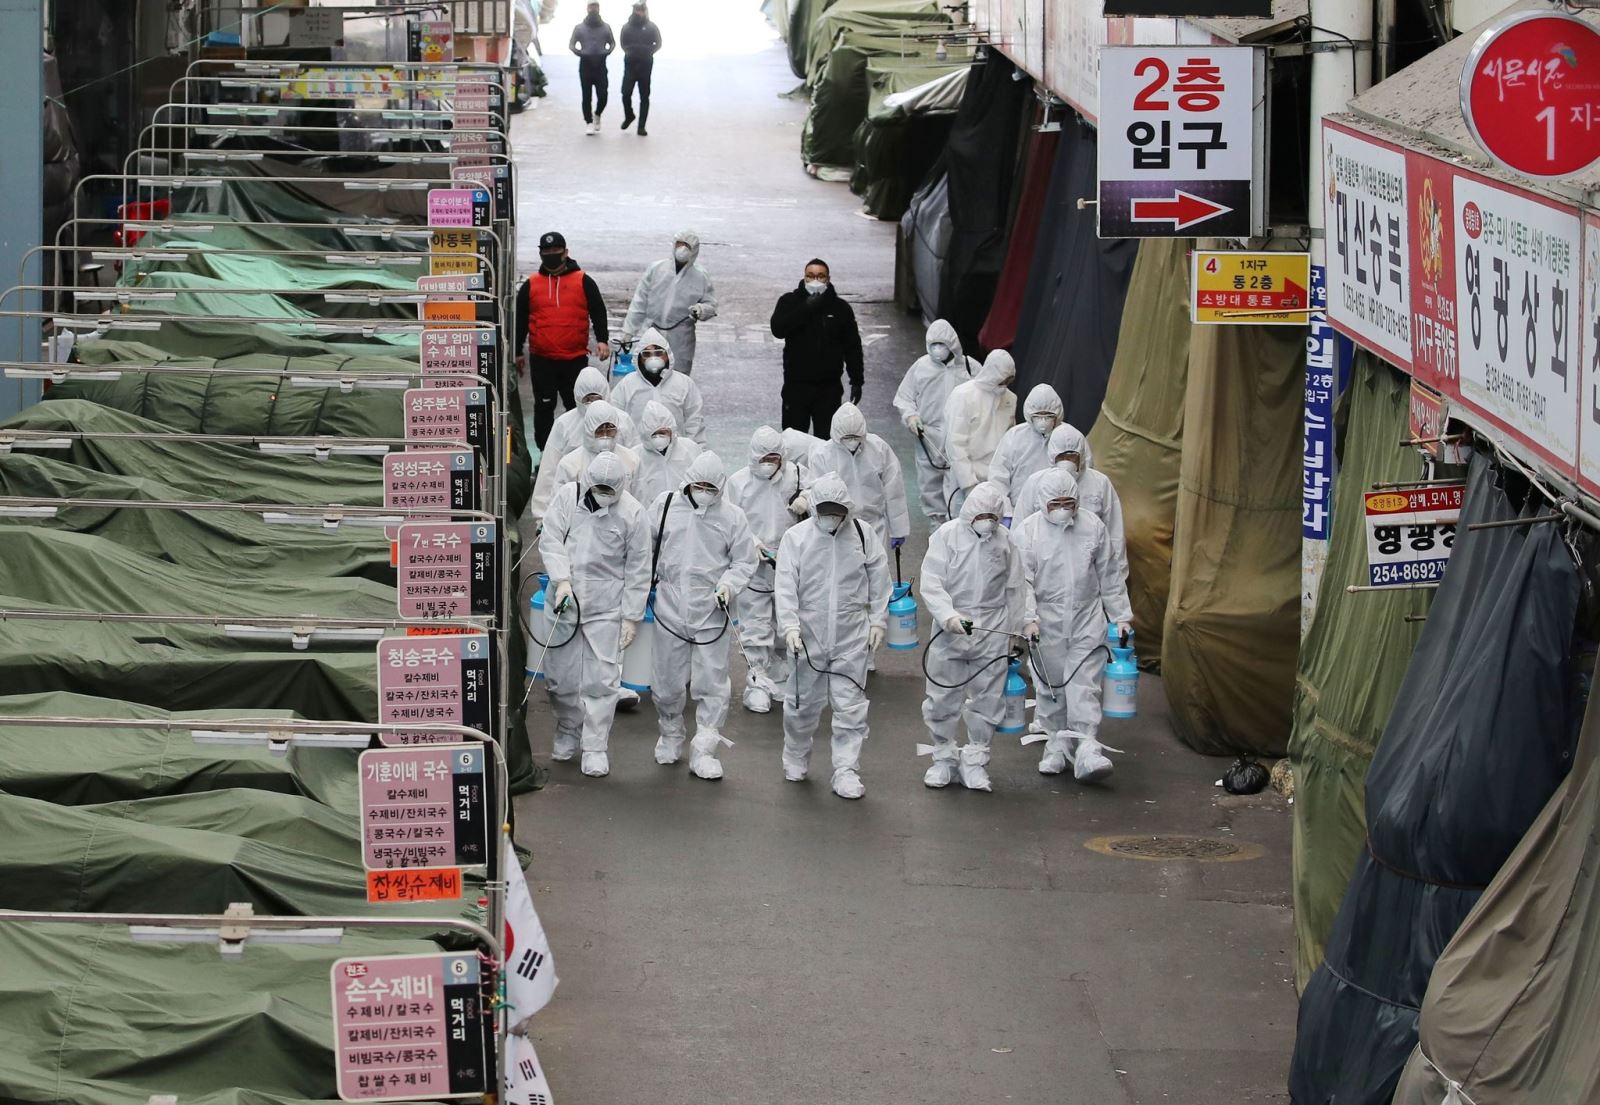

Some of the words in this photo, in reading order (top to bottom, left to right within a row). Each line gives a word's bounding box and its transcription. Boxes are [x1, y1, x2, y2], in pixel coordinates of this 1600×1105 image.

[1133, 57, 1225, 112] 2층
[1482, 57, 1565, 102] 서문시장
[1535, 106, 1556, 161] 1
[1570, 103, 1600, 131] 지
[1126, 120, 1228, 170] 입구
[433, 233, 472, 248] 아동복
[1336, 189, 1402, 303] 대신승복
[1205, 258, 1218, 273] 4
[1240, 259, 1268, 272] 1지구
[1233, 276, 1246, 290] 동
[1250, 275, 1273, 290] 2층
[1201, 293, 1241, 307] 소방대
[1247, 293, 1273, 306] 통로
[1465, 243, 1568, 393] 영광상회
[427, 345, 472, 358] 수제비
[1414, 312, 1434, 364] 1지구
[1435, 321, 1456, 380] 중앙동
[480, 352, 488, 374] 먹거리
[411, 396, 460, 411] 성주분식
[1305, 389, 1329, 403] 입구
[469, 412, 478, 437] 먹거리
[391, 461, 445, 477] 정성국수
[455, 479, 463, 505] 먹거리
[432, 533, 461, 548] 국수
[409, 554, 462, 563] 칼국수/수제비
[475, 552, 484, 580] 먹거리
[1373, 562, 1437, 583] 254-8692
[416, 601, 458, 610] 비빔국수
[388, 647, 455, 667] 청송국수
[404, 672, 440, 682] 칼수제비
[466, 669, 477, 702] 먹거리
[386, 690, 459, 701] 칼국수/잔치국수
[391, 707, 455, 718] 수제비/냉국수
[368, 760, 418, 782] 기훈이네
[423, 759, 449, 781] 국수
[387, 788, 428, 800] 칼수제비
[459, 785, 471, 821] 먹거리
[369, 807, 448, 820] 수제비/잔치국수
[374, 827, 445, 839] 콩국수/칼국수
[374, 846, 447, 858] 냉국수/비빔국수
[346, 964, 367, 976] 원조
[454, 963, 464, 974] 6
[345, 975, 433, 1002] 손수제비
[451, 998, 465, 1041] 먹거리
[348, 1026, 436, 1041] 칼제비/잔치국수
[349, 1049, 438, 1064] 비빔국수/콩국수
[358, 1072, 432, 1087] 찹쌀수제비
